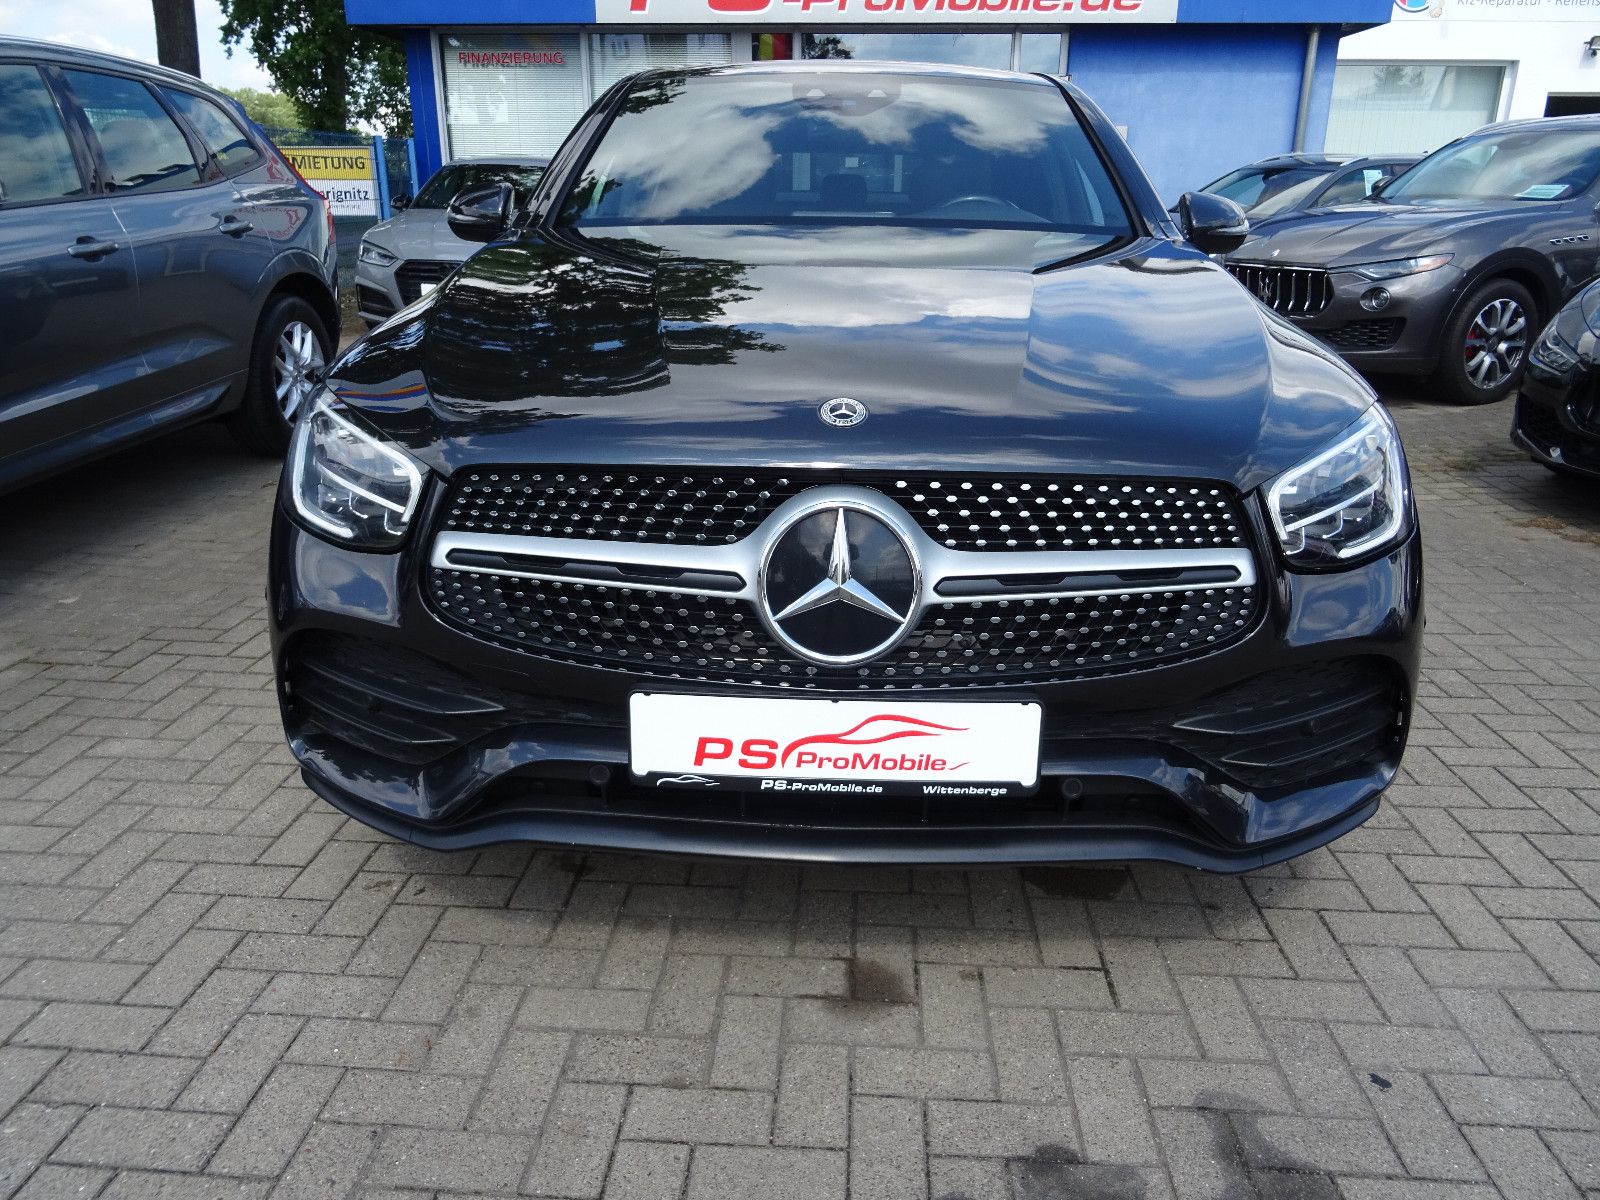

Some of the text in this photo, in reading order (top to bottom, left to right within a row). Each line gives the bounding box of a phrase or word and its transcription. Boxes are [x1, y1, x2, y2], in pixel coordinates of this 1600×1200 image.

[458, 52, 564, 64] FINANZIERUNG
[286, 155, 366, 170] MIETUNG
[693, 736, 947, 771] PS ProMobile
[760, 780, 1008, 797] PS-ProMobile.de Wittenberge
